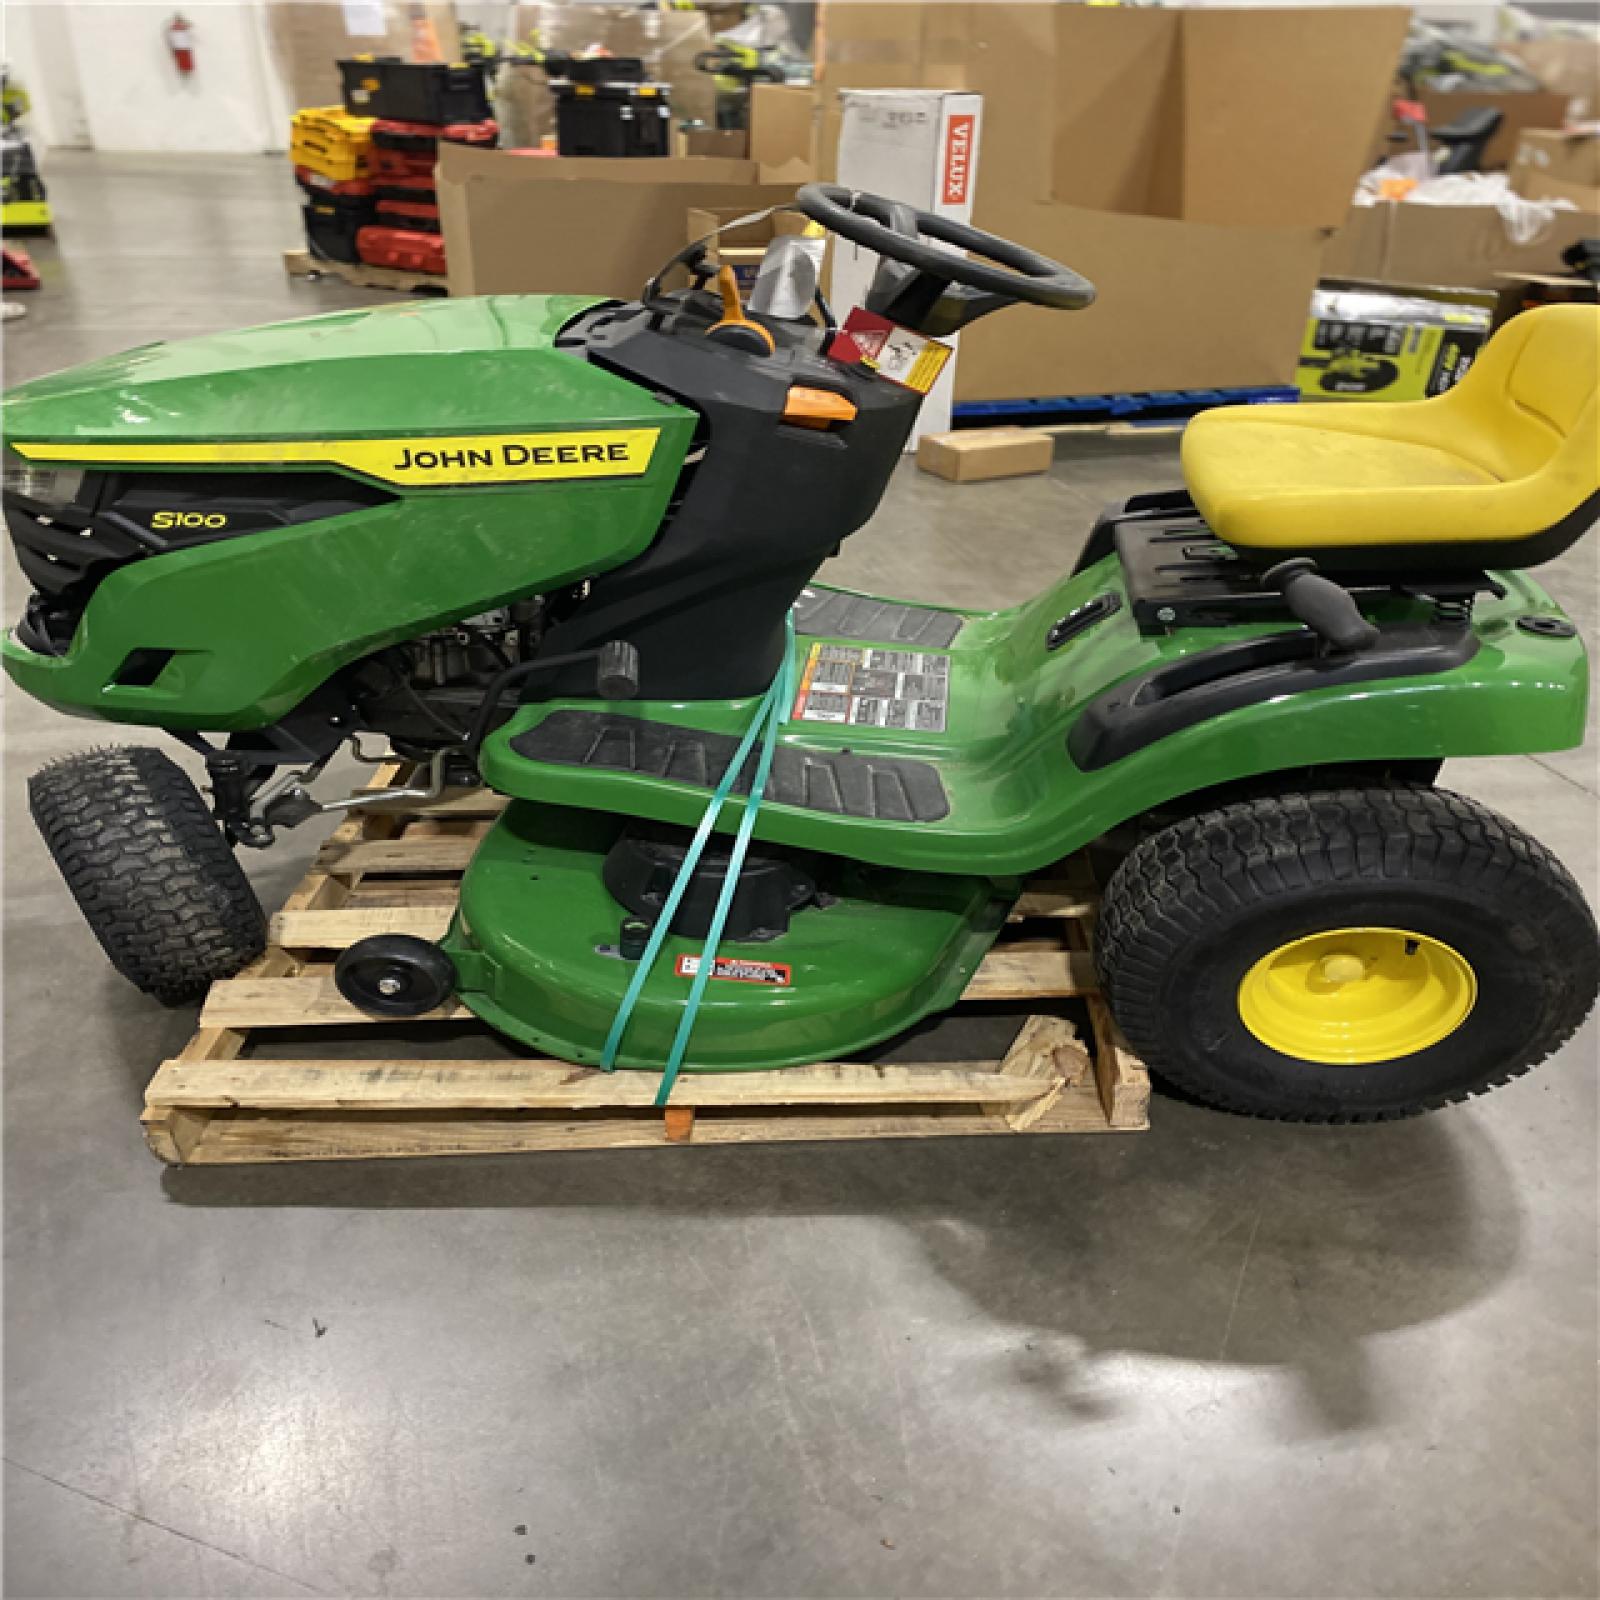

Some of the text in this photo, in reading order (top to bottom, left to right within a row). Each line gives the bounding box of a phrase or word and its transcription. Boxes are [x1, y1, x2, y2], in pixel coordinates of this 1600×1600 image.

[949, 121, 970, 197] VELUX
[394, 443, 631, 471] JOHN DEERE
[151, 510, 227, 530] S100
